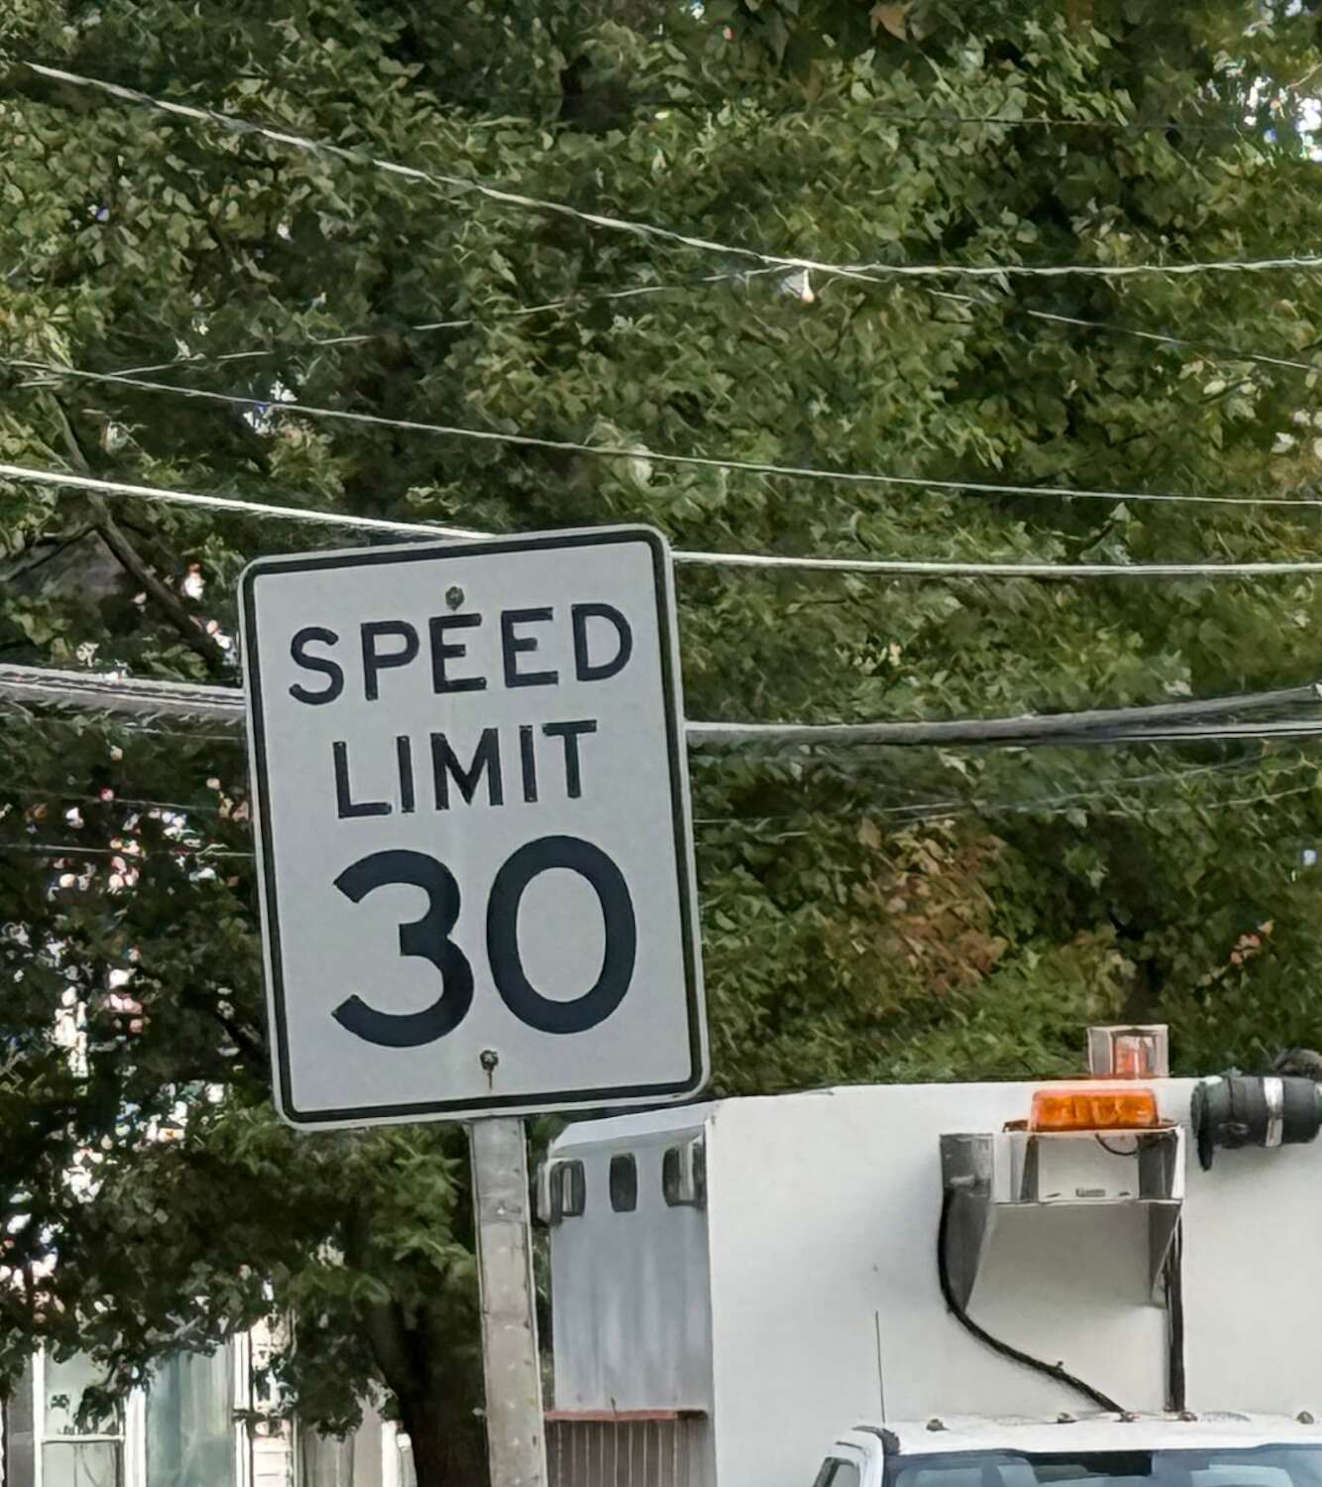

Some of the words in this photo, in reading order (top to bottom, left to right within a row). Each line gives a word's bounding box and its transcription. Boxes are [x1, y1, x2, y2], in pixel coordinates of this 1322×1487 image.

[288, 602, 634, 705] SPEED
[332, 719, 598, 820] LIMIT
[331, 834, 638, 1048] 30
